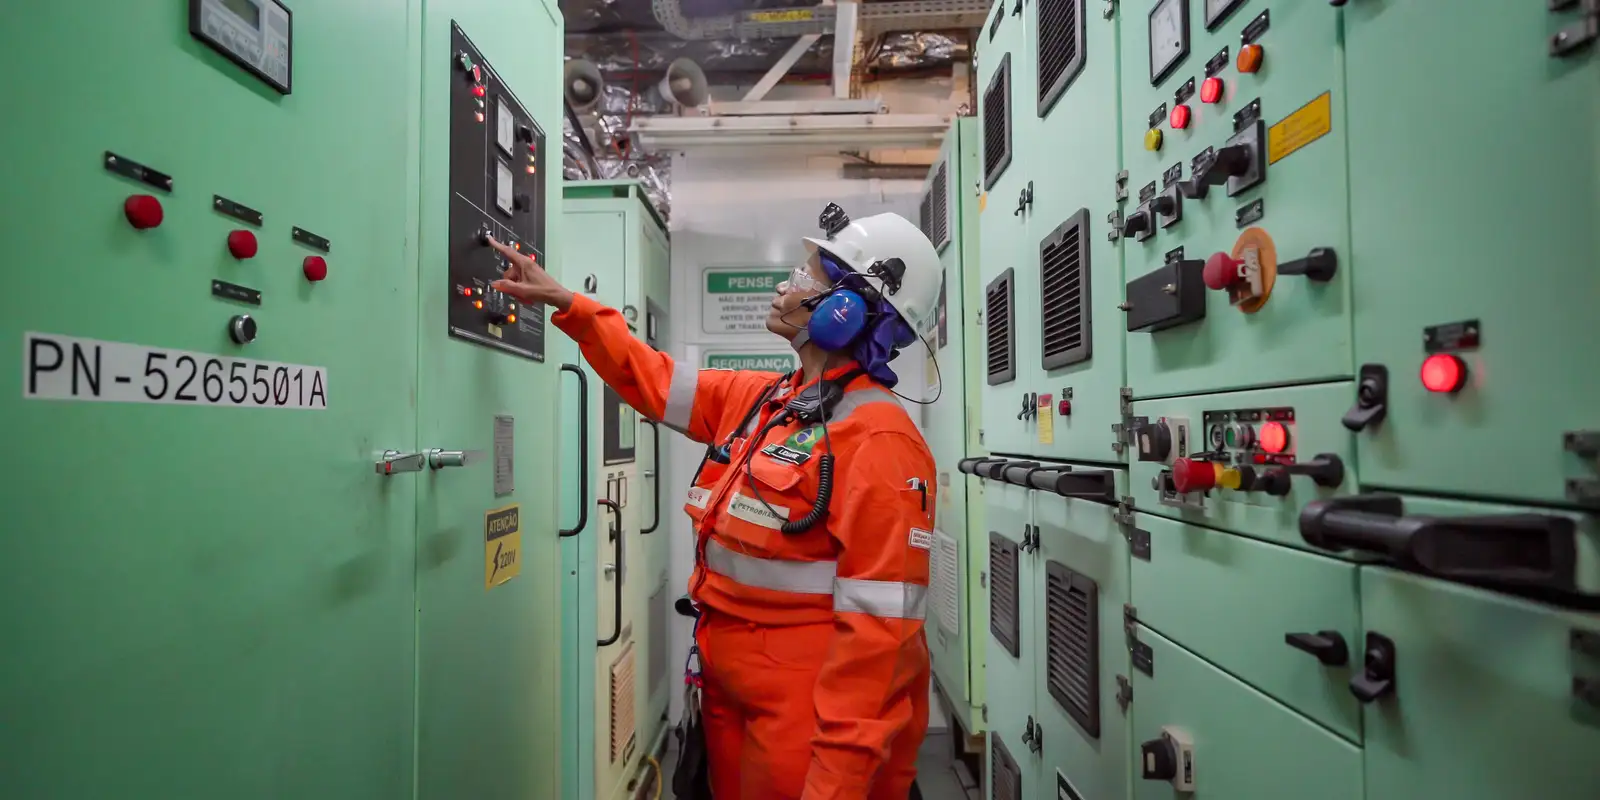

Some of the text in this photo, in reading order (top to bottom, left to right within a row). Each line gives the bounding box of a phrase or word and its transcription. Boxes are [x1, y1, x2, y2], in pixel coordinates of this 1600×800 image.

[728, 277, 774, 288] PENSE
[711, 357, 792, 372] SEGURANÇA
[488, 512, 518, 534] ATENÇÃO
[500, 549, 516, 568] 220V
